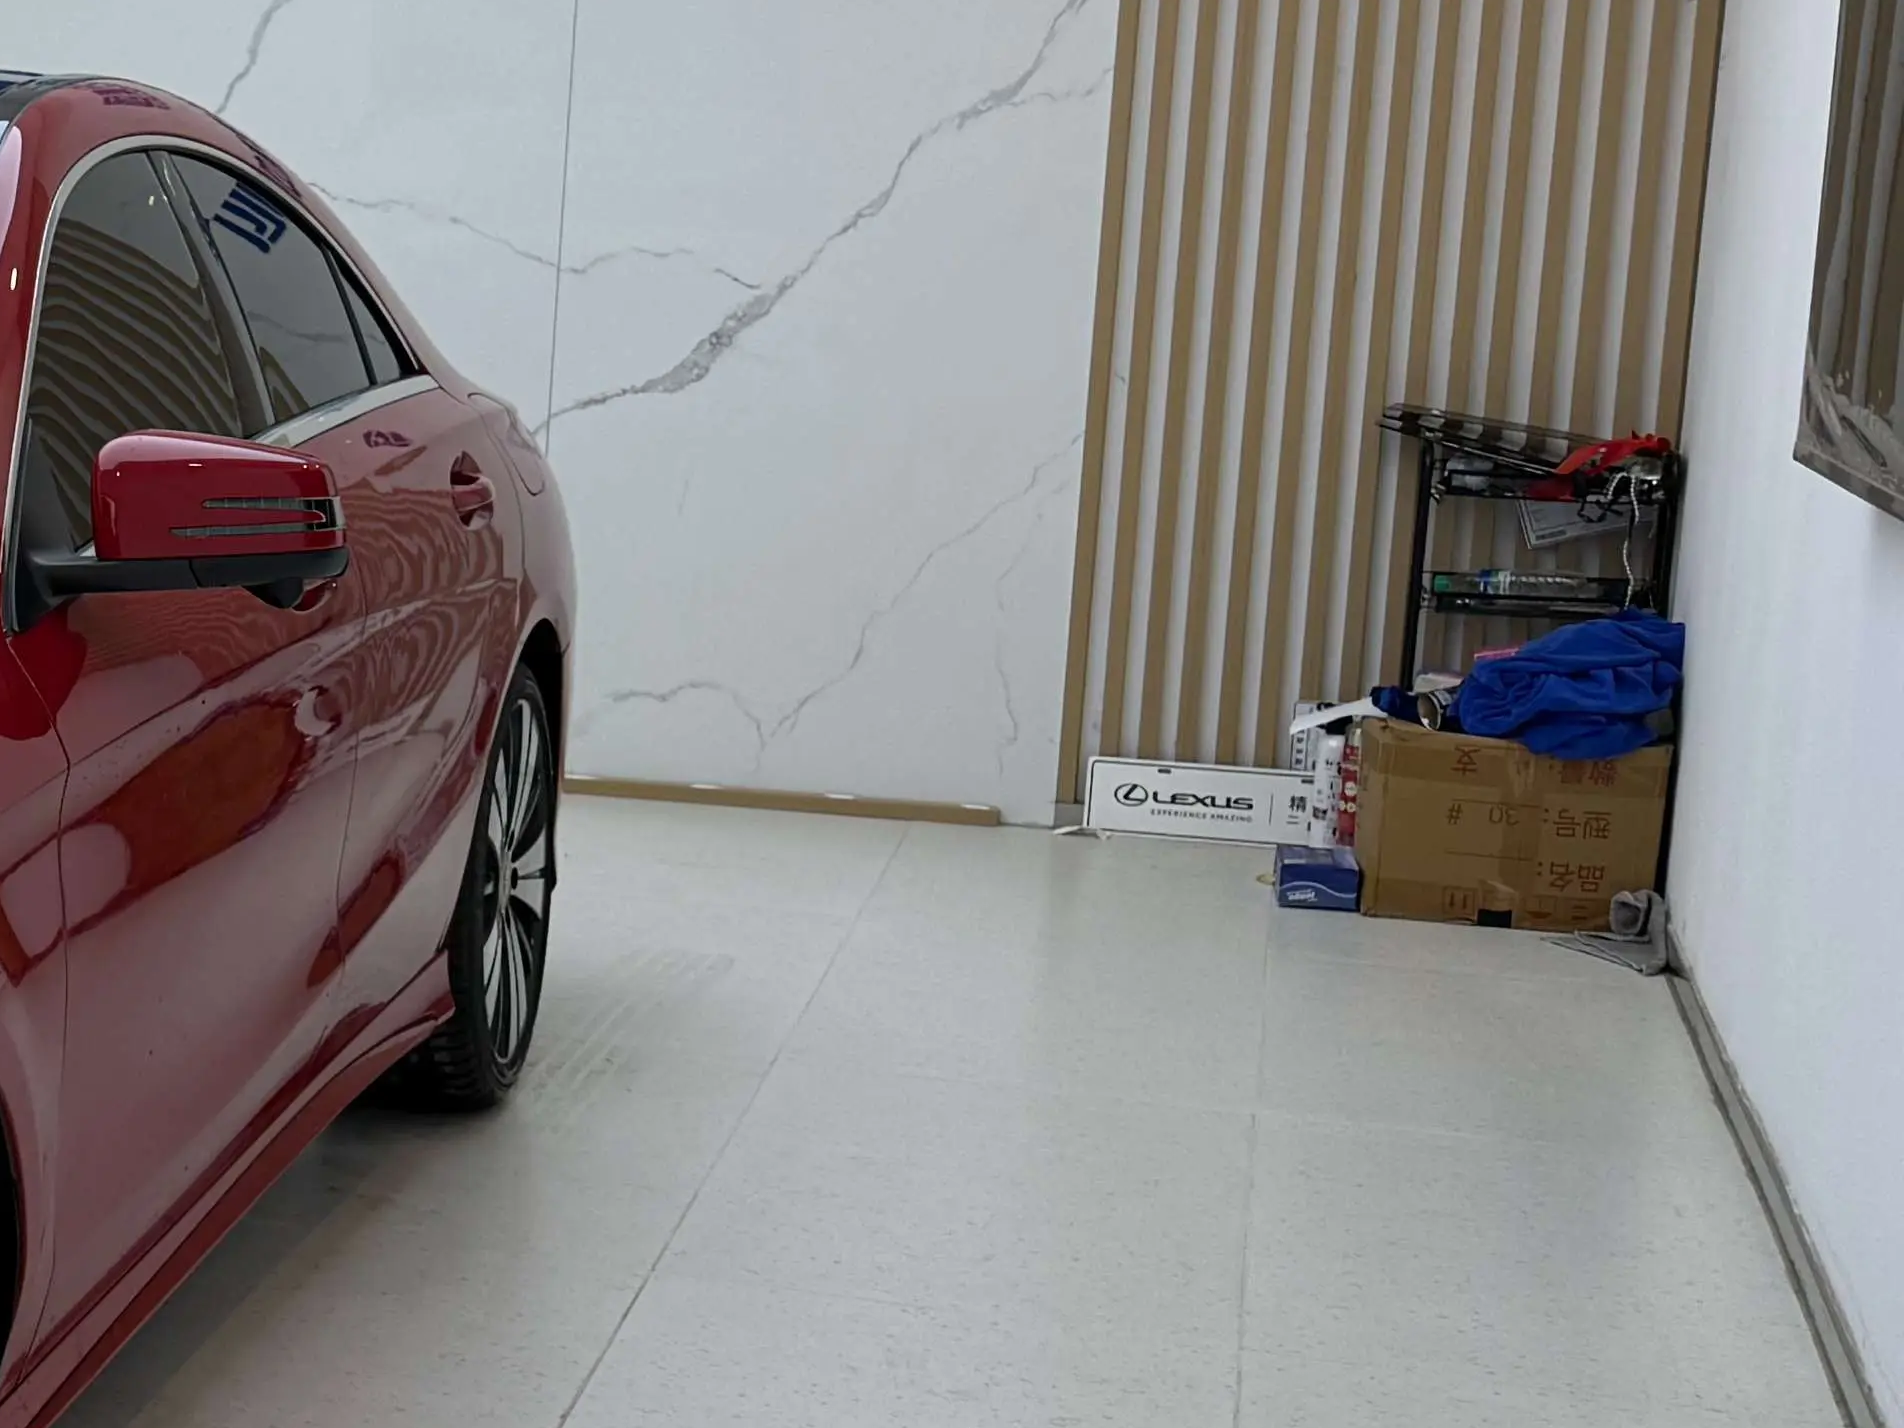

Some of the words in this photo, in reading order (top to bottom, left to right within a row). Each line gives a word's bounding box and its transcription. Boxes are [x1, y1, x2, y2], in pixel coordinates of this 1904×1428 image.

[1153, 791, 1253, 811] LEXUS
[1150, 808, 1207, 820] EXPERIENCE
[1211, 811, 1253, 823] AMAZING
